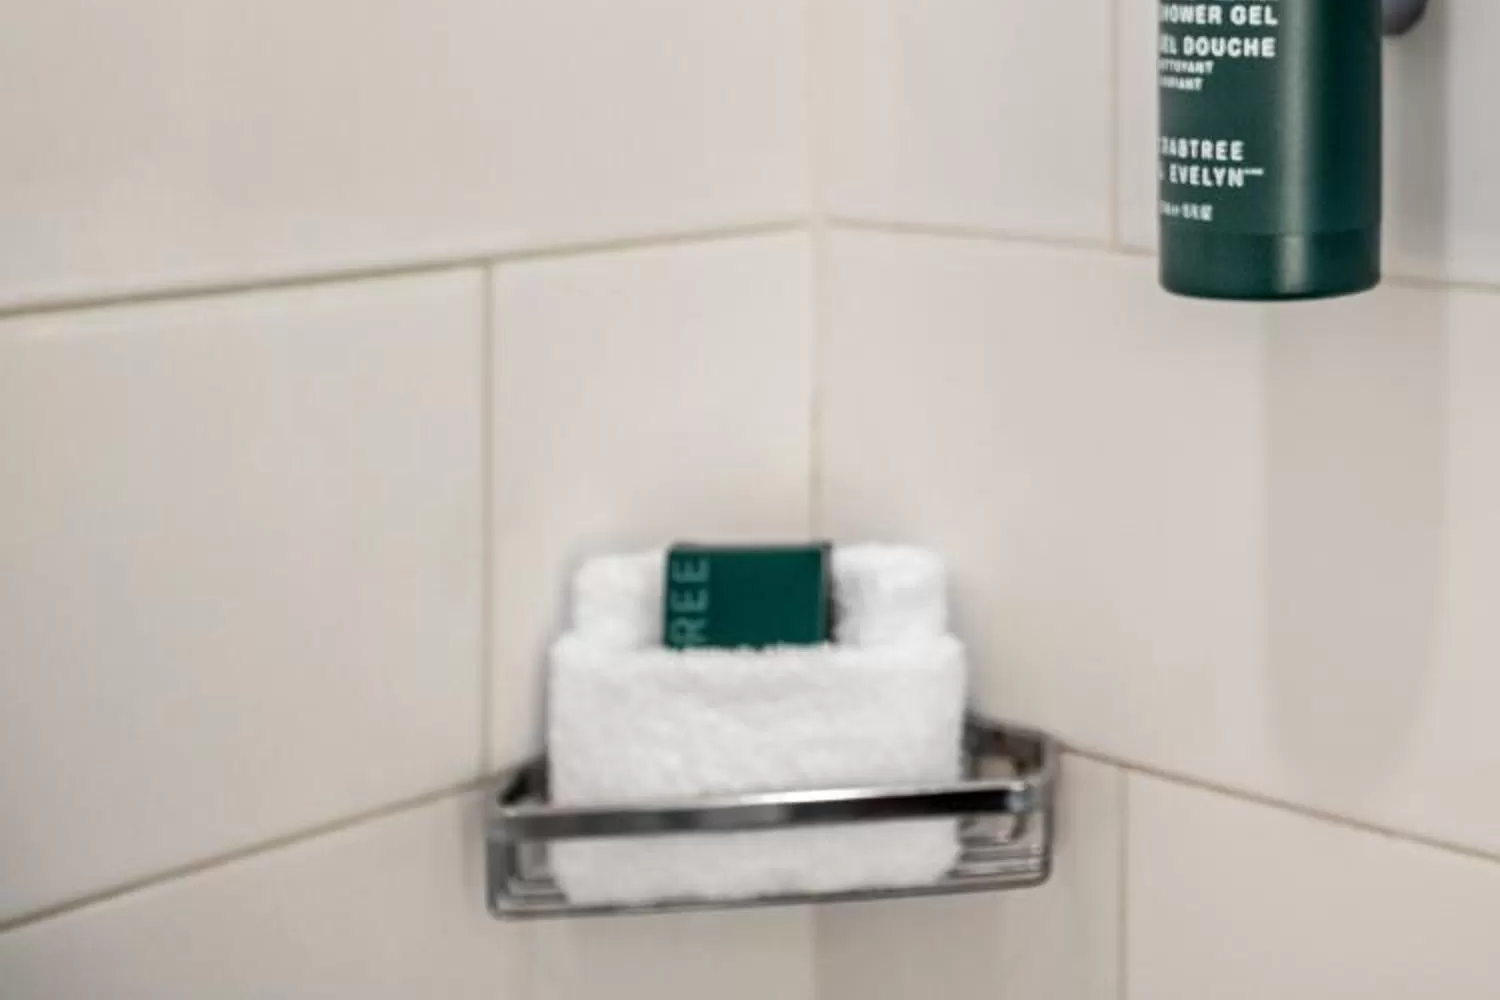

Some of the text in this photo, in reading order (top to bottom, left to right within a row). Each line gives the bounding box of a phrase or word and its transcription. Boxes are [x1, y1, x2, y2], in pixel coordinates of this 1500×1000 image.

[1230, 4, 1279, 26] GEL
[1183, 35, 1276, 58] DOUCHE
[1169, 163, 1244, 188] EVELYN
